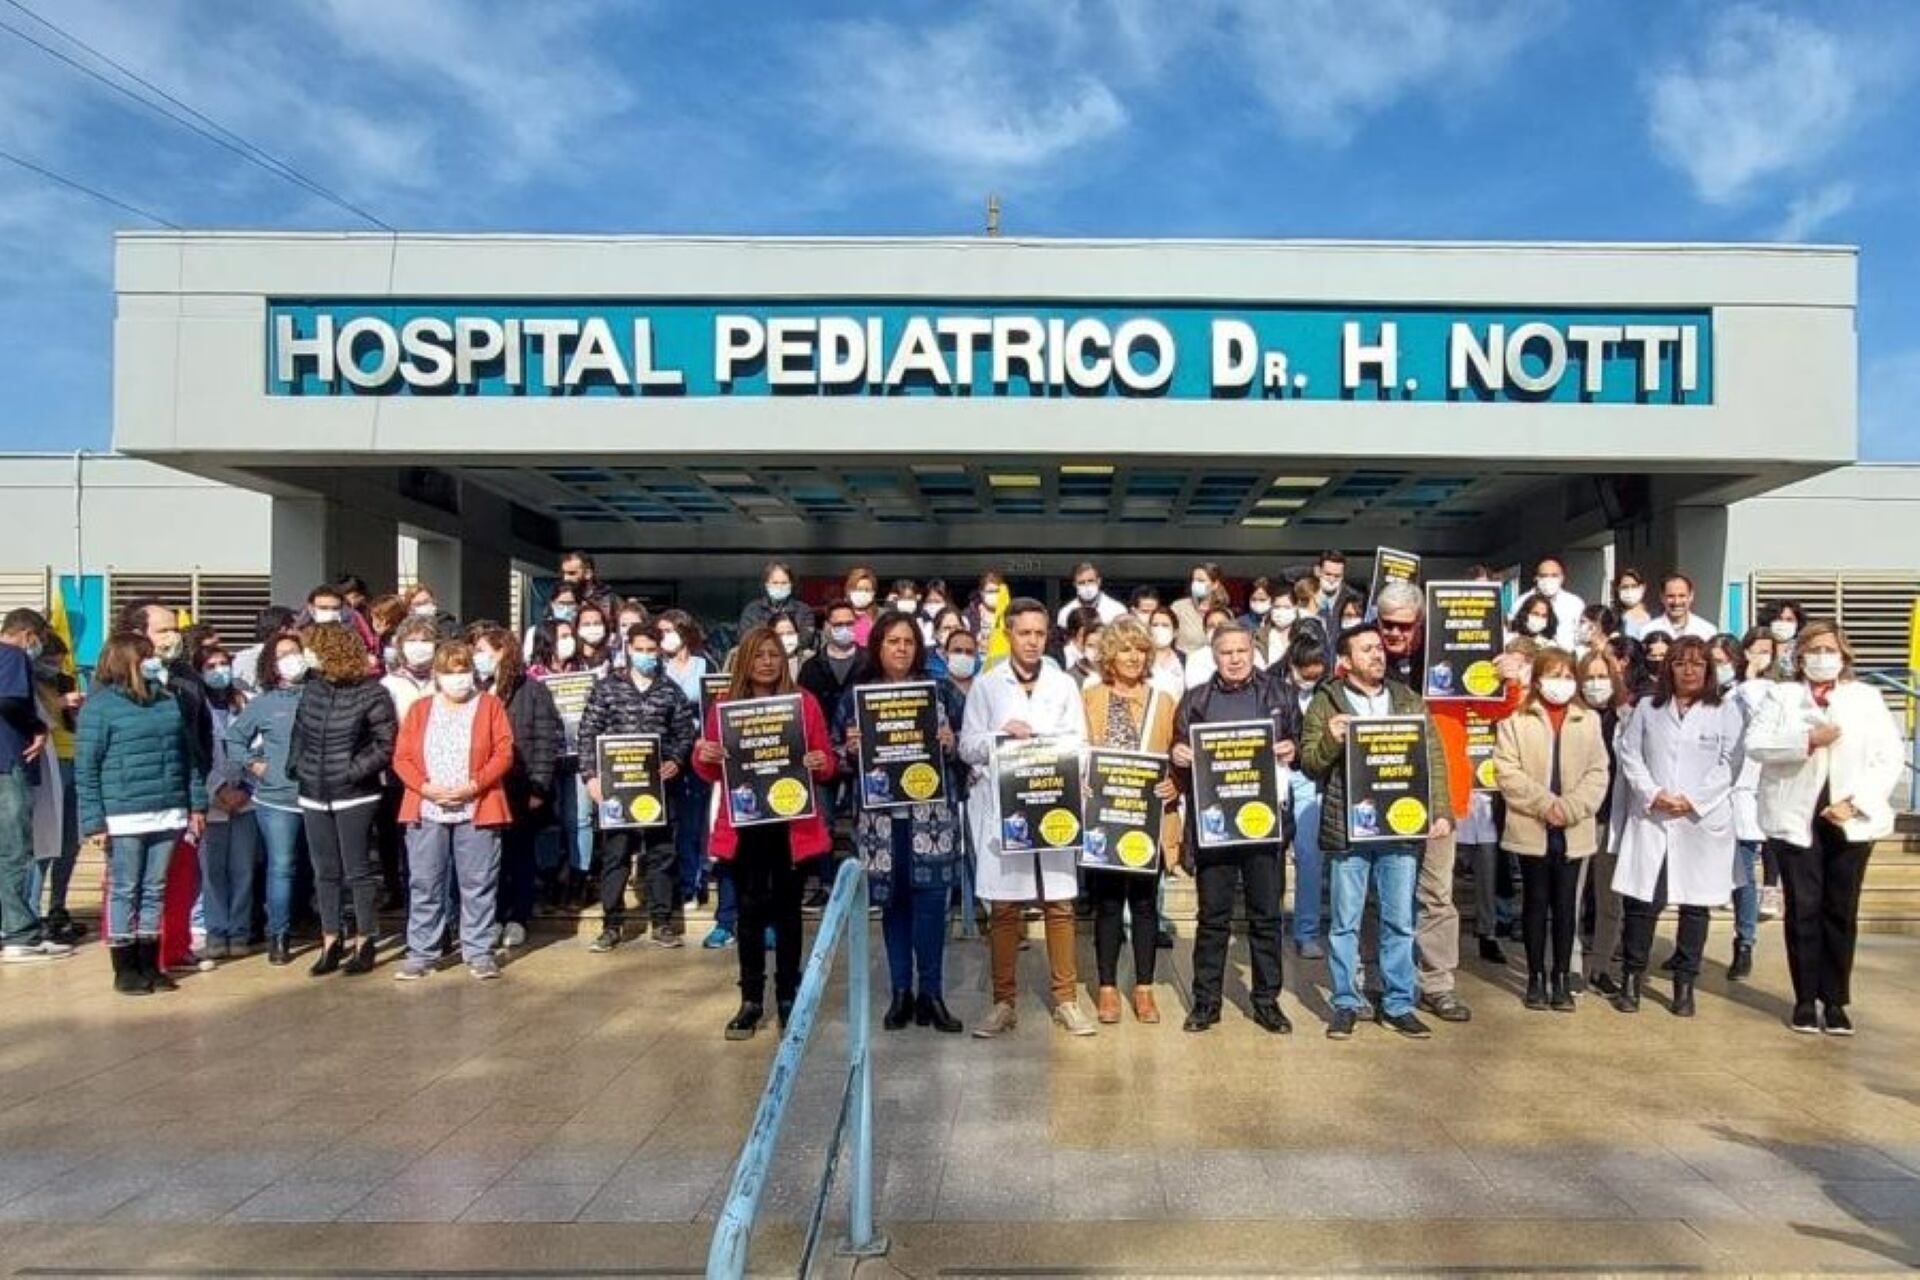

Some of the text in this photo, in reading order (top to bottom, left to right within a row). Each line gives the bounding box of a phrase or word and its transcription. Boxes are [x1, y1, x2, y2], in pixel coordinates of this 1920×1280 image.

[276, 315, 682, 388] HOSPITAL
[715, 316, 1174, 389] PEDIATRICO
[1343, 321, 1418, 391] H.
[1450, 322, 1698, 393] NOTTI
